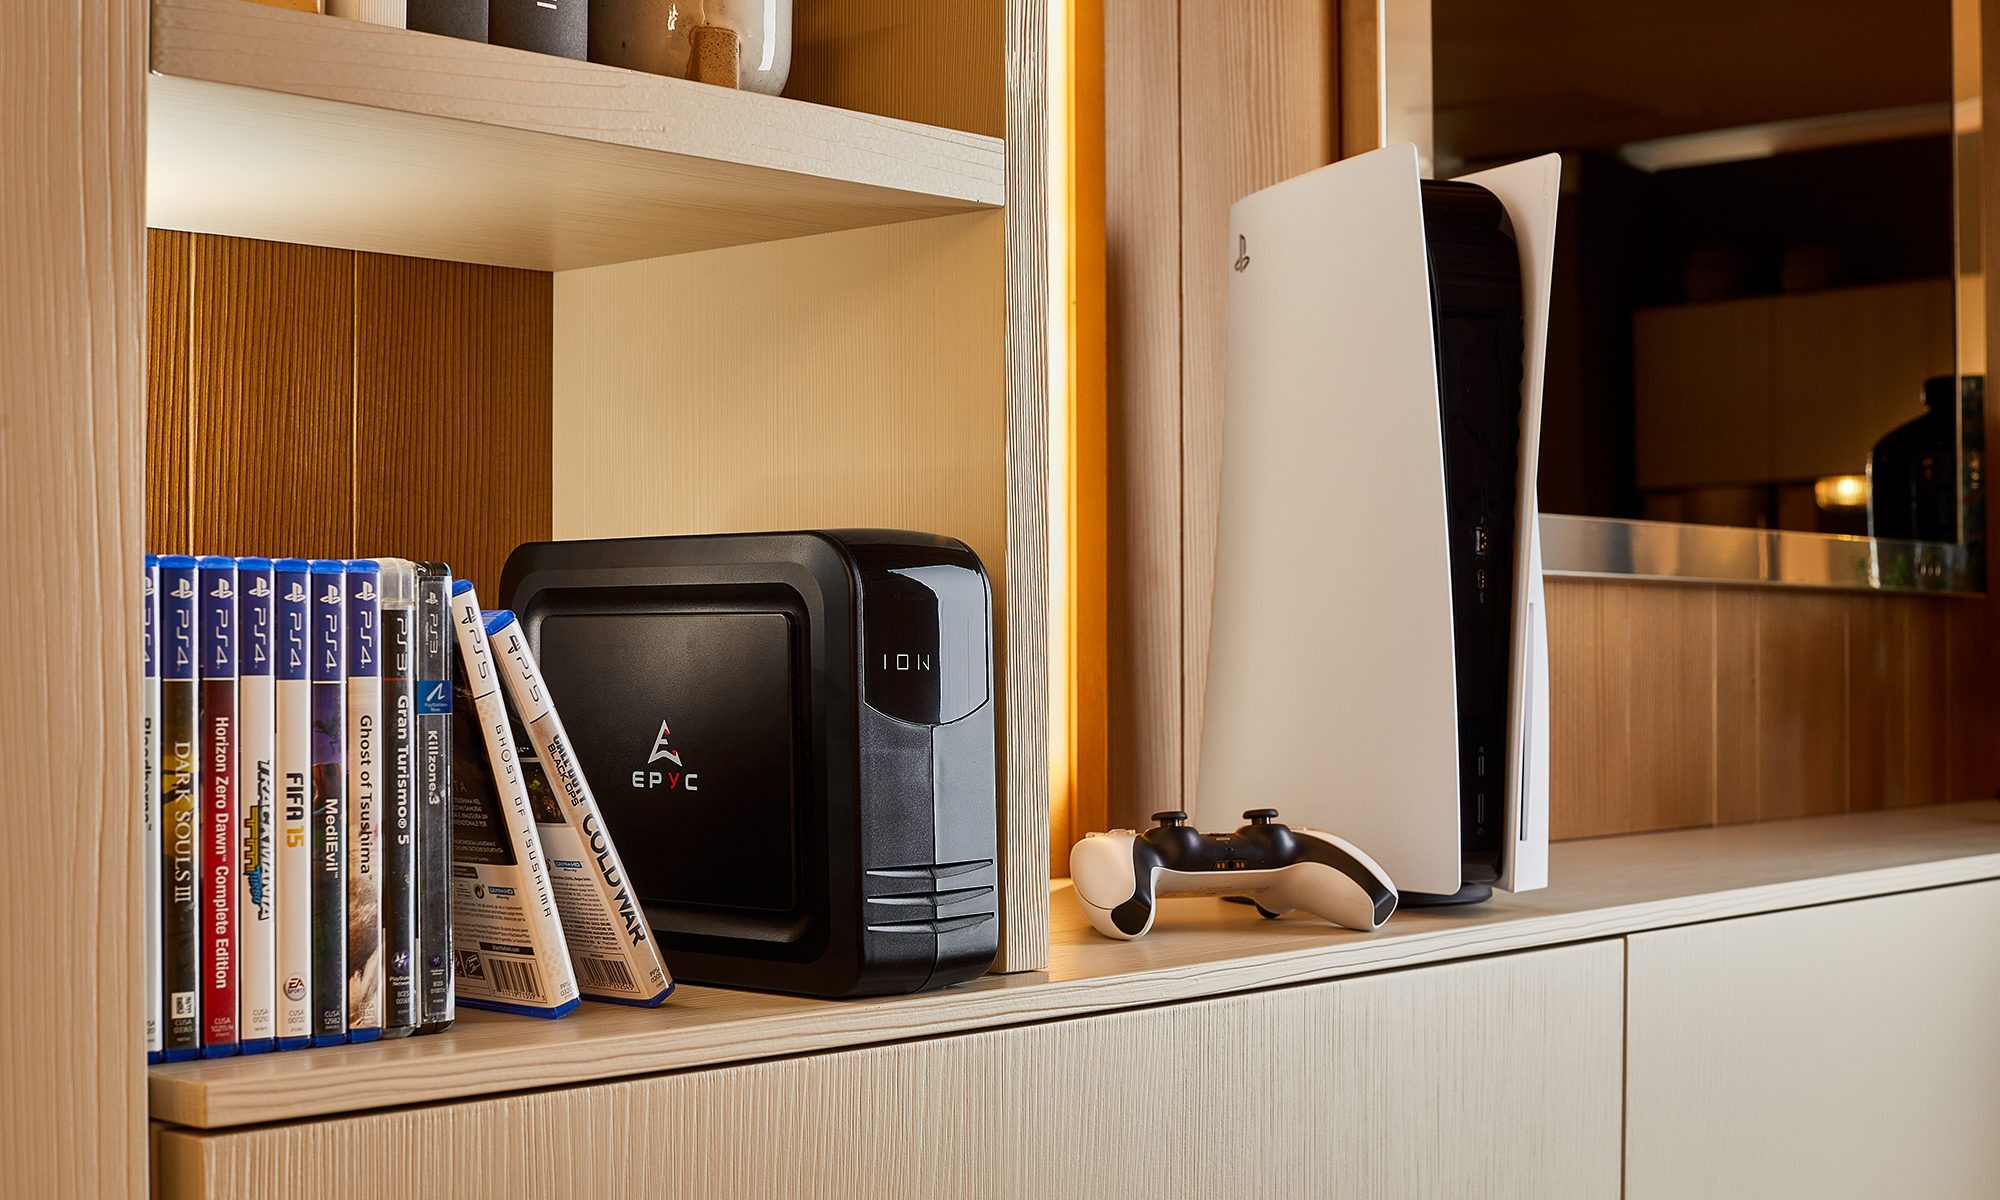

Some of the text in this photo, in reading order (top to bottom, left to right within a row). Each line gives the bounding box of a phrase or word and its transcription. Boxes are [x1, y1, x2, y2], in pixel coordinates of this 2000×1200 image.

[176, 609, 189, 666] PS4
[216, 609, 228, 666] PS4
[254, 607, 266, 664] PS4
[290, 612, 302, 668] PS4
[325, 614, 337, 669] PS4
[360, 611, 372, 665] PS4
[396, 617, 408, 671] PS3
[429, 613, 439, 654] PS3
[469, 627, 490, 680] PS5
[516, 653, 543, 703] PS5
[883, 653, 930, 671] ION
[360, 715, 373, 766] Ghost
[397, 695, 410, 740] Gran
[215, 717, 229, 773] Horizon
[215, 776, 229, 809] Zero
[360, 770, 373, 789] of
[547, 743, 580, 807] BLACK OPS
[174, 741, 191, 903] DARK SOULS III
[286, 772, 304, 848] FIFA 15
[495, 724, 552, 918] GHOST OF TSUSHIMA
[397, 834, 410, 845] 5
[213, 865, 229, 935] Complete
[582, 812, 622, 888] COLD
[613, 886, 647, 948] WAR
[215, 938, 230, 989] Edition
[288, 978, 305, 989] EA
